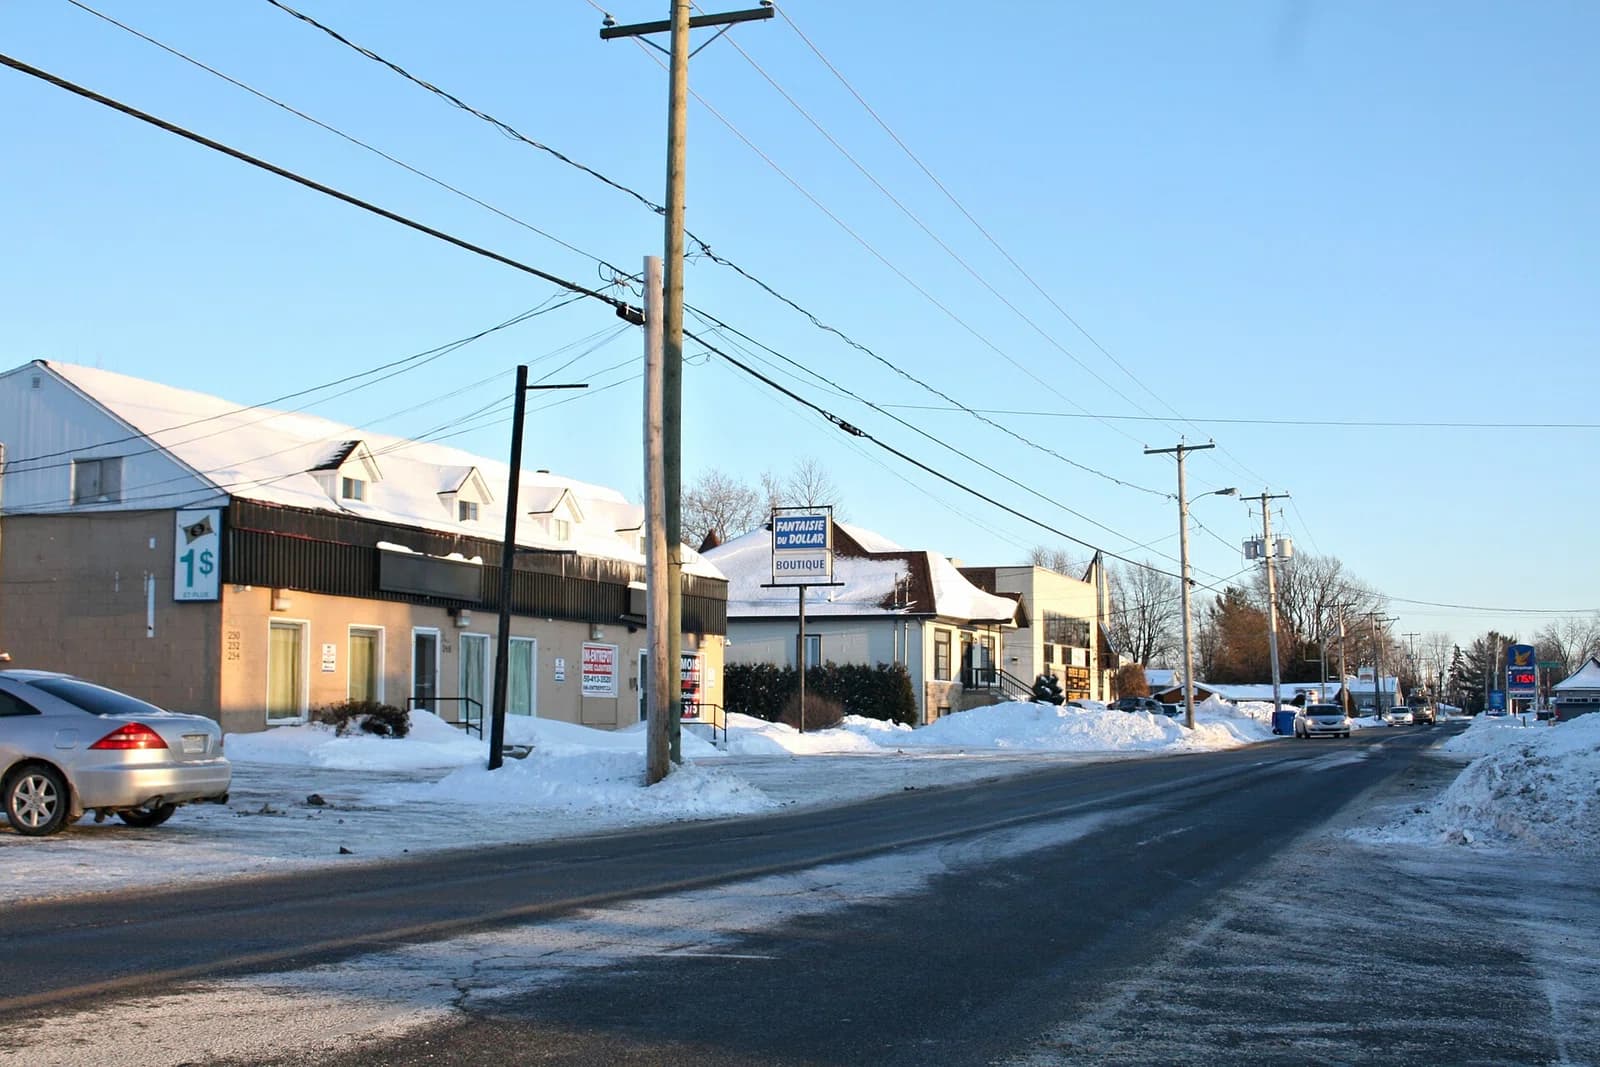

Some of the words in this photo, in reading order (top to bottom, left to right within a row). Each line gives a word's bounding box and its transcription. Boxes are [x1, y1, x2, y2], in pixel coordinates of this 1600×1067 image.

[777, 520, 824, 532] FANTAISIE
[777, 537, 787, 545] DU
[789, 533, 824, 544] DOLLAR
[776, 560, 824, 570] BOUTIQUE
[680, 657, 700, 670] MOIS
